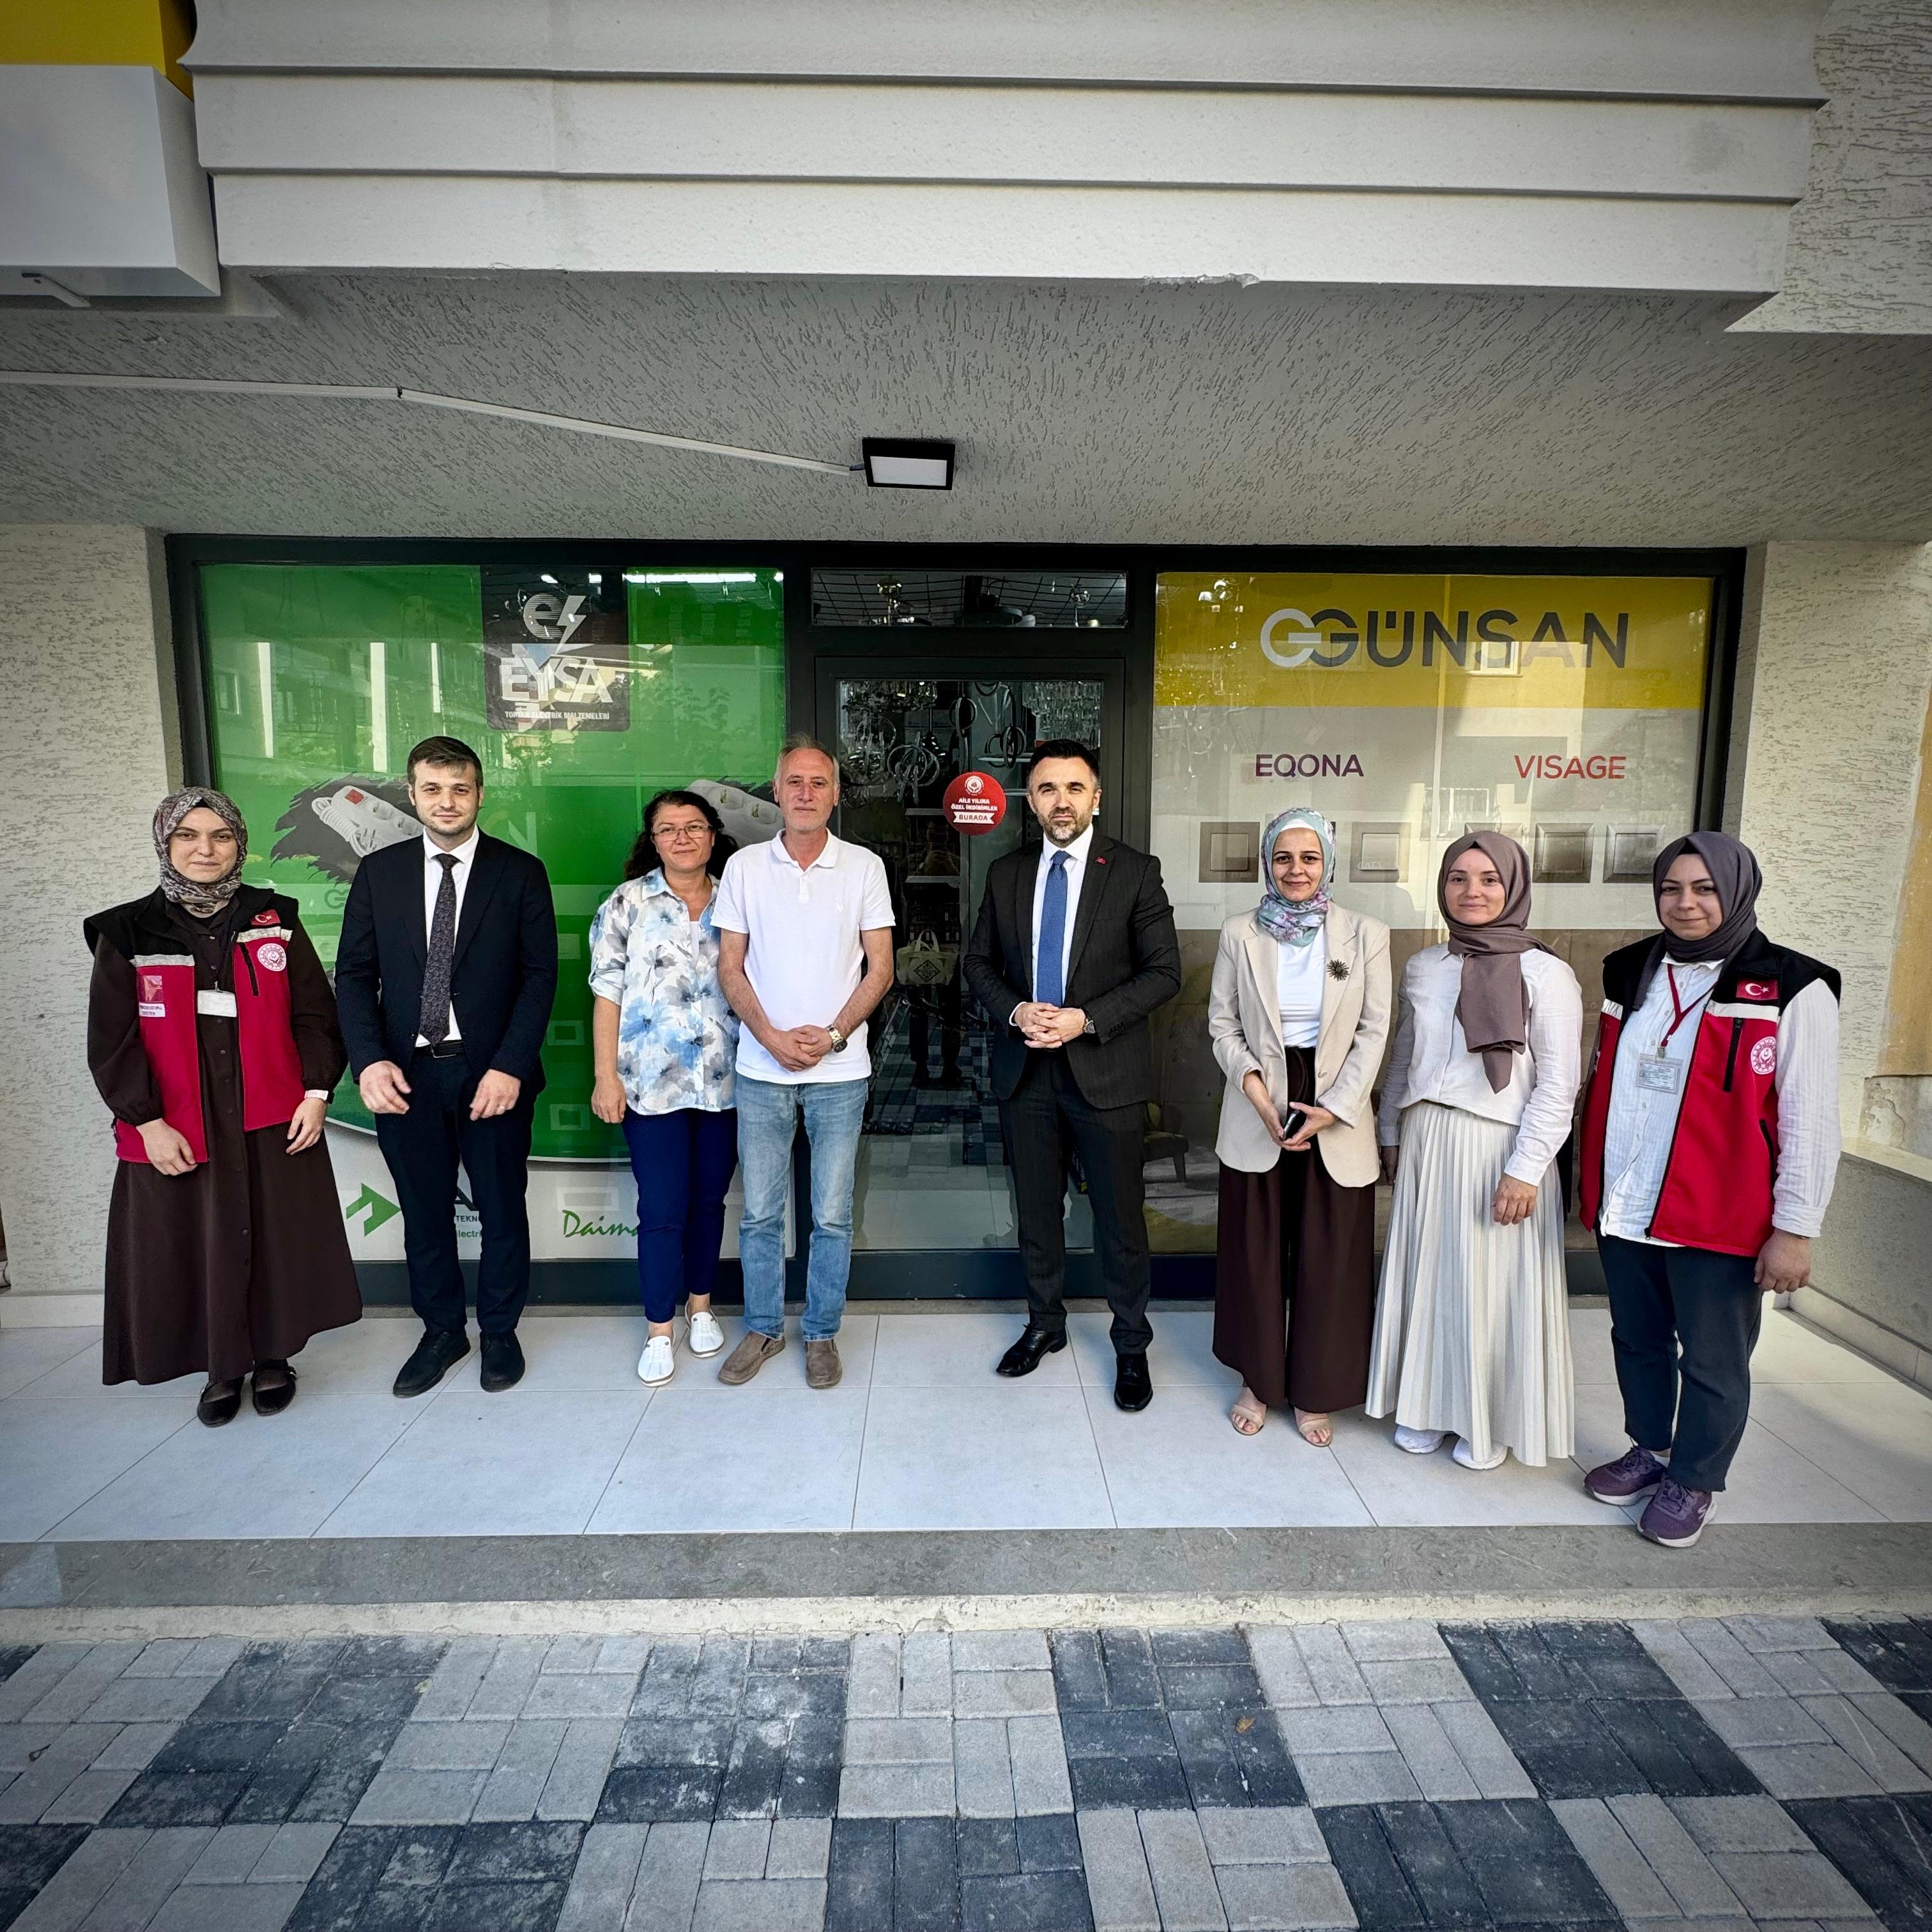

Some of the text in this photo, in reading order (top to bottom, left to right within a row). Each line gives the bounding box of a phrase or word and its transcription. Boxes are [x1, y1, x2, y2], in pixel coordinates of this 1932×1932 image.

[500, 657, 614, 703] EYSA
[564, 711, 610, 720] MALZEMELERİ
[1255, 754, 1365, 778] EQONA
[1514, 755, 1626, 779] VISAGE
